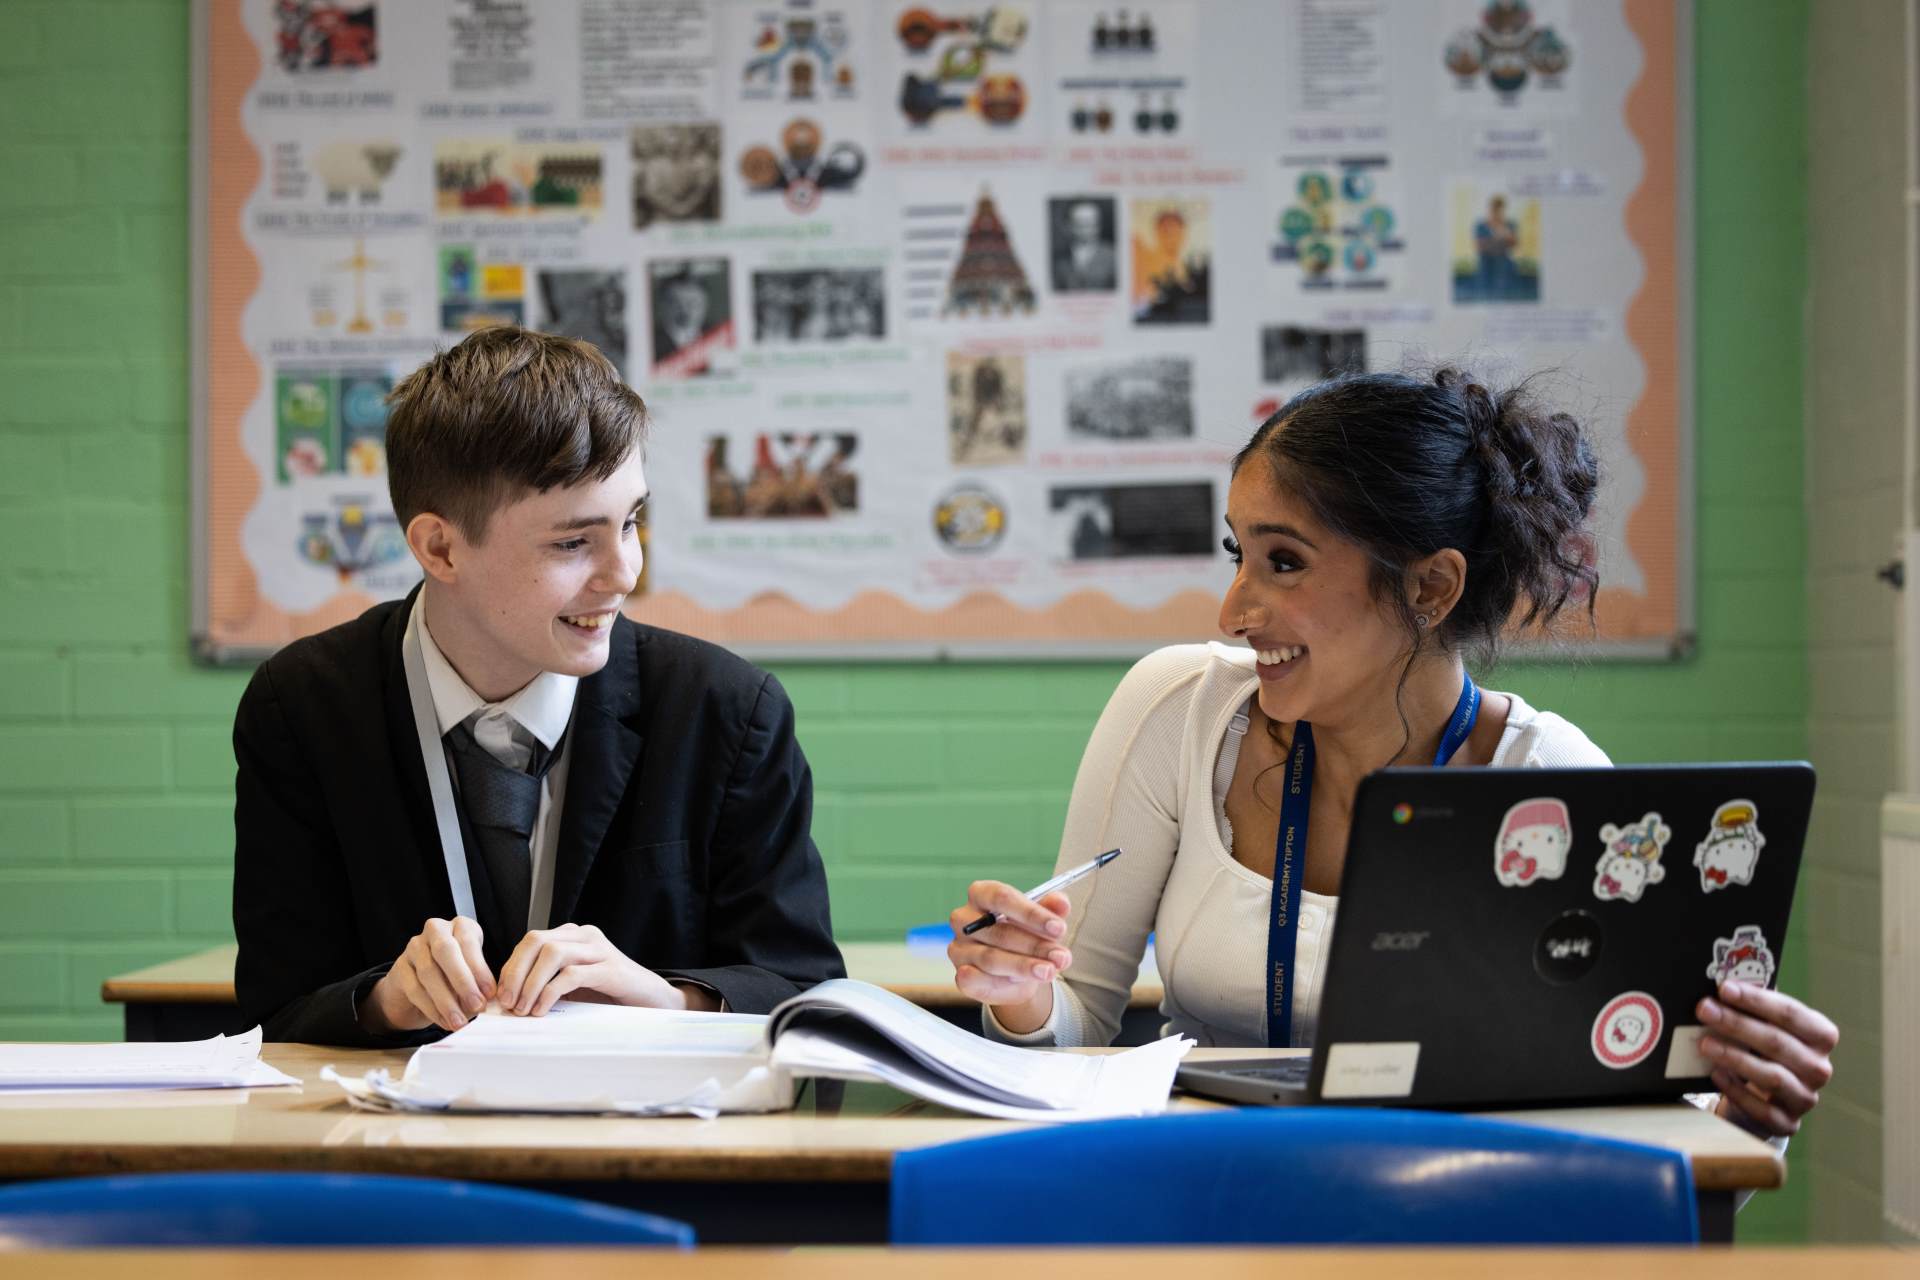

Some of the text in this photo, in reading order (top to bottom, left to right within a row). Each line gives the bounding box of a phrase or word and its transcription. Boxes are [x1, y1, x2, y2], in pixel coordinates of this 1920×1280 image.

[1291, 744, 1305, 795] STUDENT
[1278, 826, 1295, 927] Q3 ACADEMY TIPTON
[1371, 931, 1431, 950] acer
[1273, 961, 1285, 1015] STUDENT
